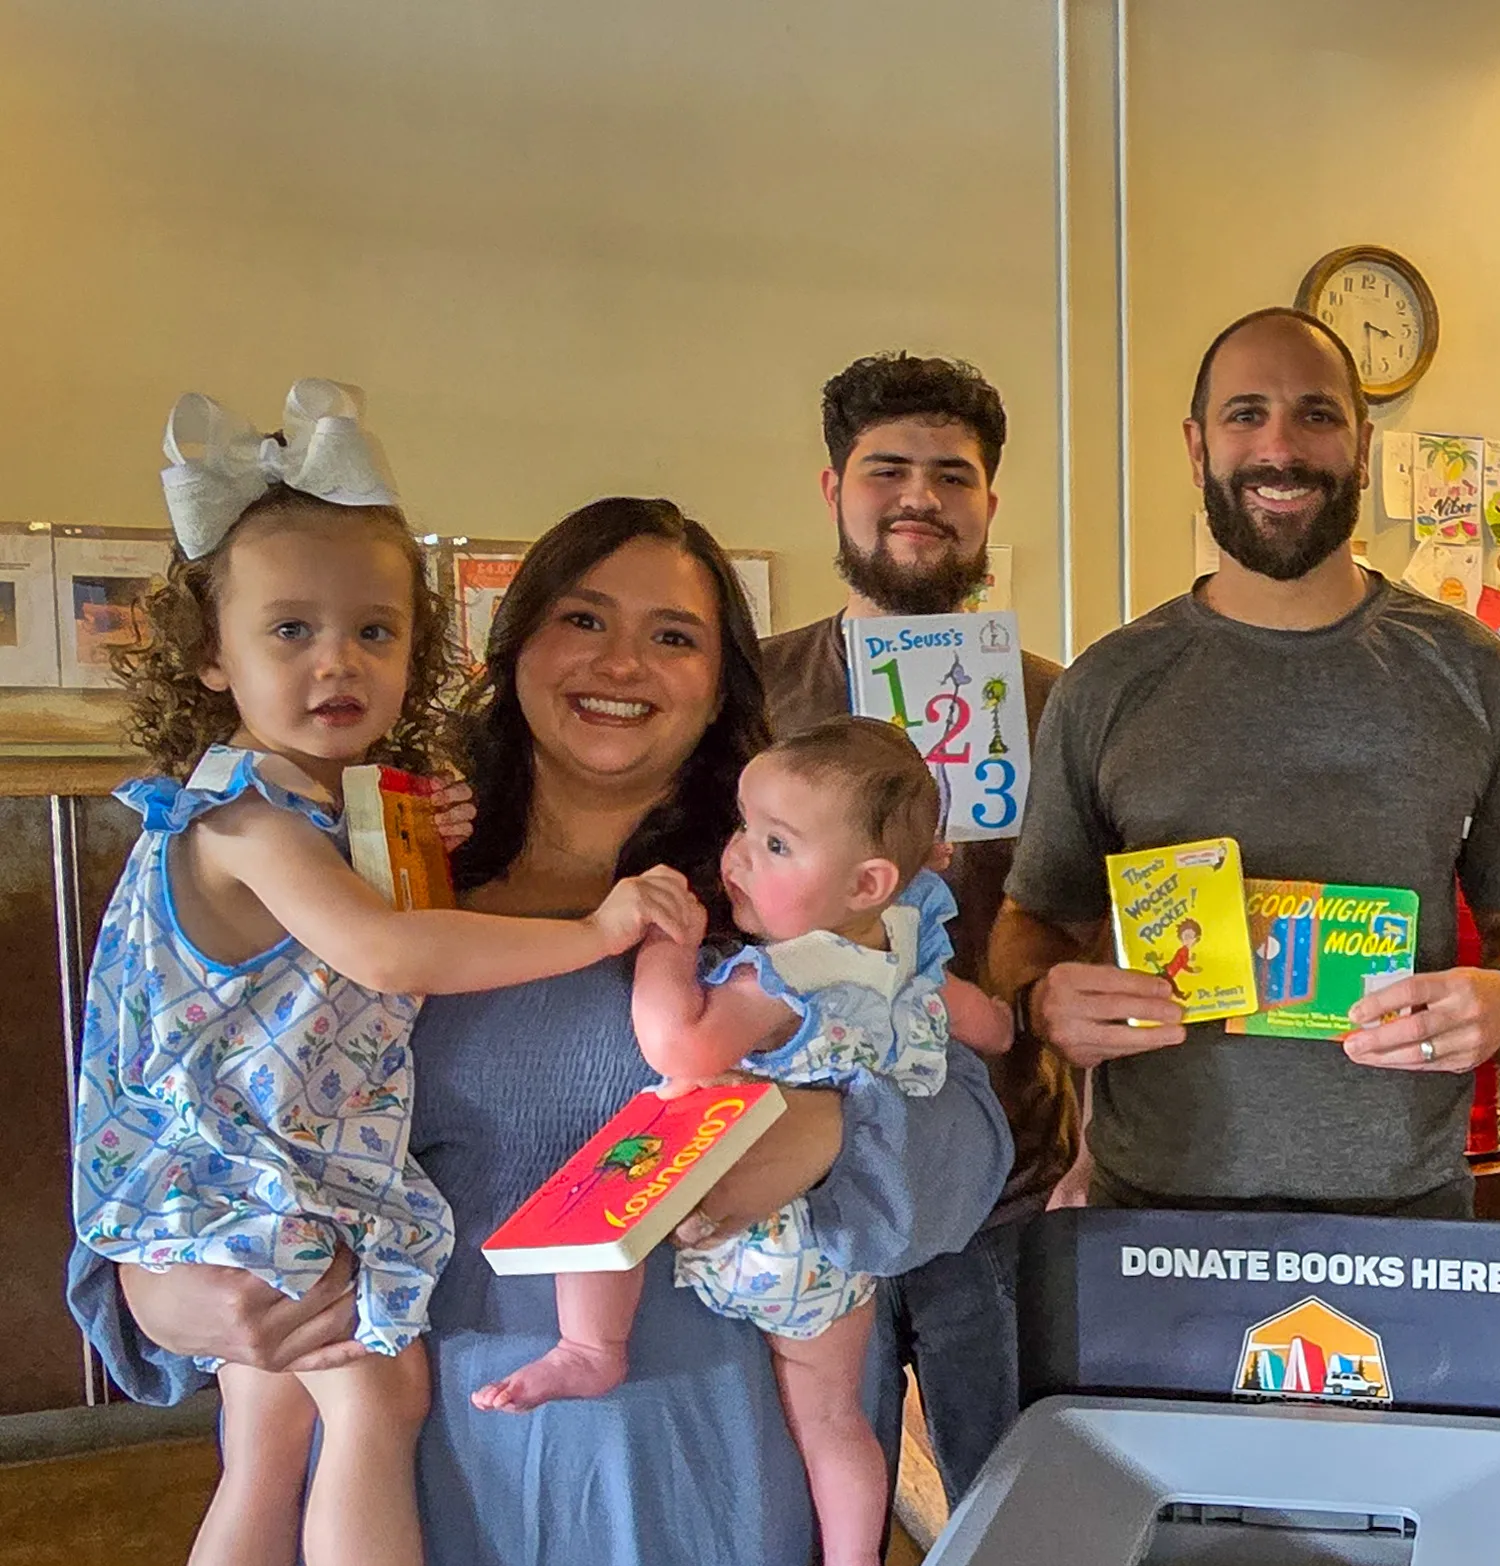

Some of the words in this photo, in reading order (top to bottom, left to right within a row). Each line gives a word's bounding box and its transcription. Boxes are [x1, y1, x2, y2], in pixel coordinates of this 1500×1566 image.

[1361, 274, 1376, 290] 12
[1396, 300, 1406, 315] 2
[866, 637, 897, 658] Dr.
[900, 629, 963, 650] Seuss's
[872, 658, 923, 728] 1
[925, 694, 971, 763] 2
[972, 758, 1017, 828] 3
[1124, 873, 1178, 920] WOCKET
[1248, 893, 1390, 923] GOODNIGHT
[1324, 931, 1398, 956] MOON
[604, 1098, 745, 1228] CORDUROY
[1121, 1246, 1270, 1281] DONATE
[1276, 1252, 1403, 1288] BOOKS
